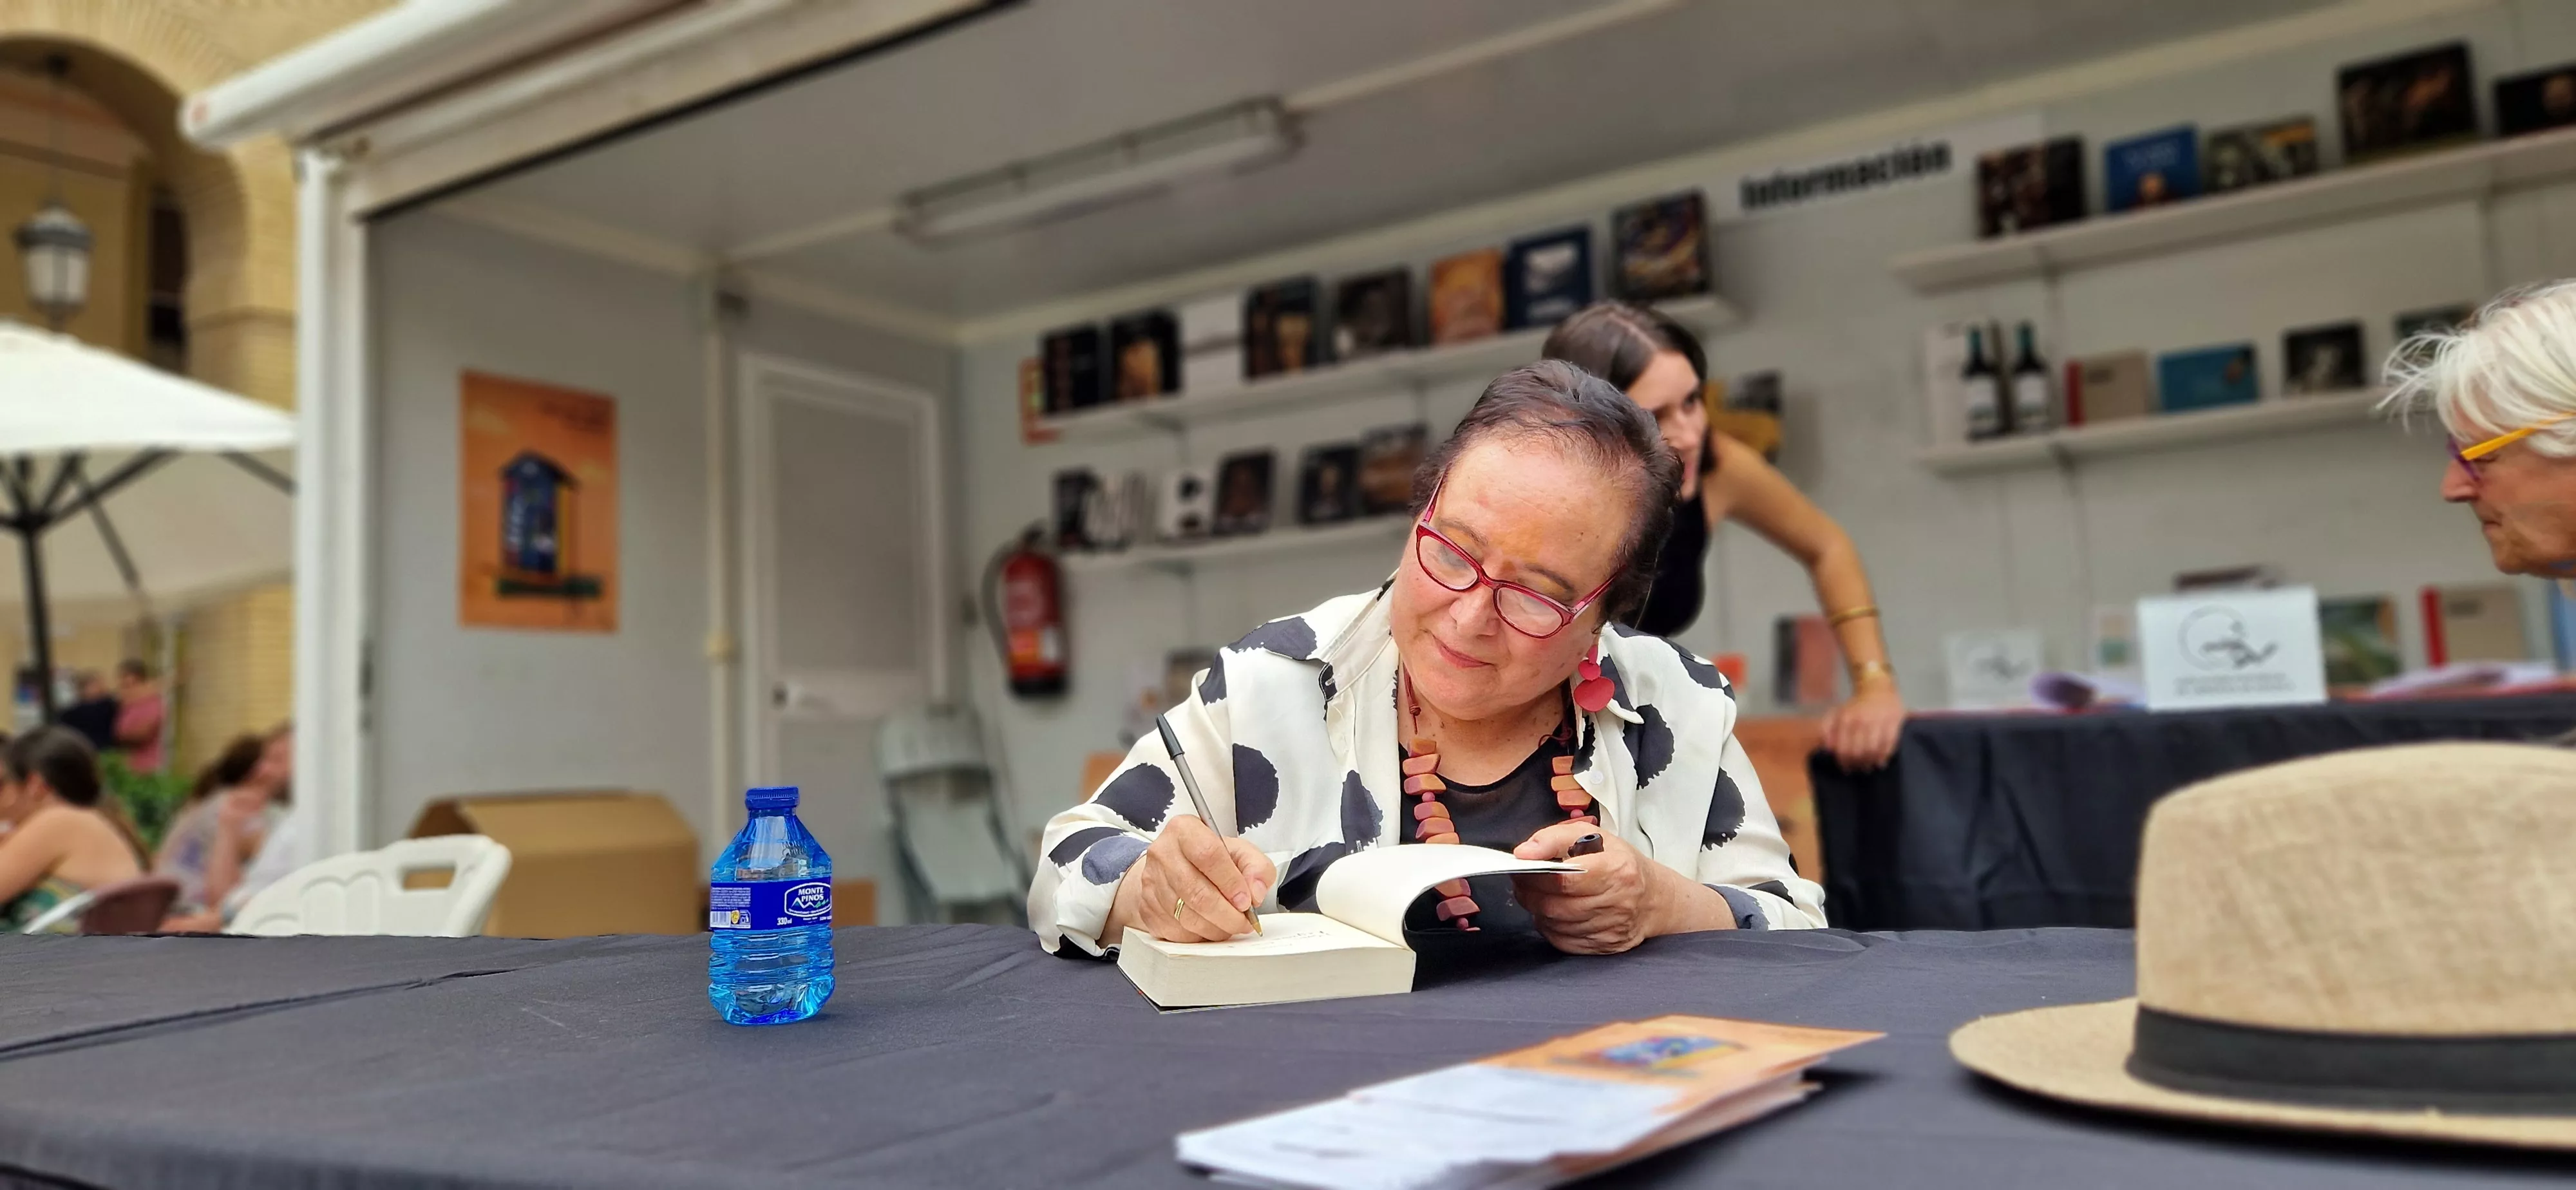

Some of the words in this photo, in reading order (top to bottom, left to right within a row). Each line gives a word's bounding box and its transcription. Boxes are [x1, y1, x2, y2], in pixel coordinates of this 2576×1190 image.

[1740, 138, 1951, 211] Información
[798, 887, 824, 895] MONTE
[801, 894, 824, 902] PINOS
